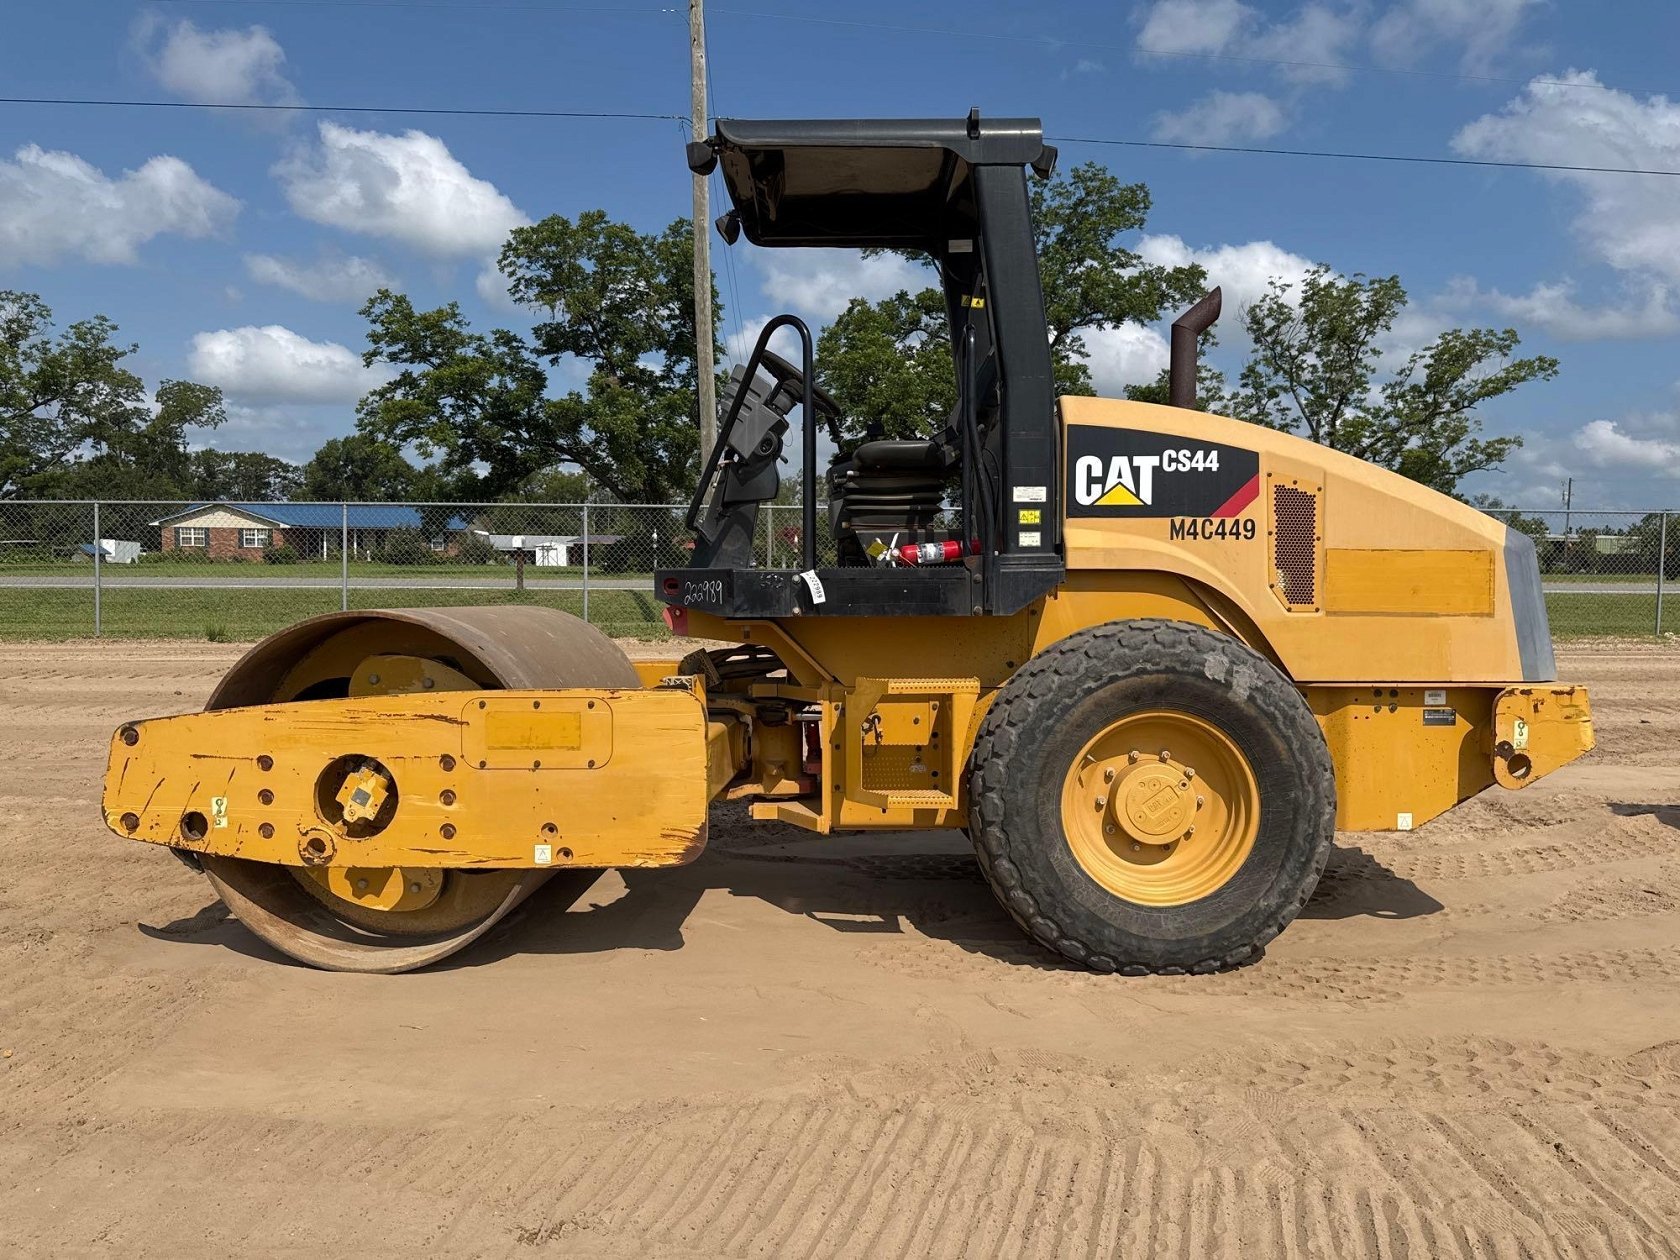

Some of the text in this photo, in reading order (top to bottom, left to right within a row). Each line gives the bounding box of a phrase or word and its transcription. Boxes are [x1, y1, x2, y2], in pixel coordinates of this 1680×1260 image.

[1162, 449, 1219, 472] CS44
[1075, 455, 1160, 506] CAT
[1169, 518, 1256, 540] M4C449
